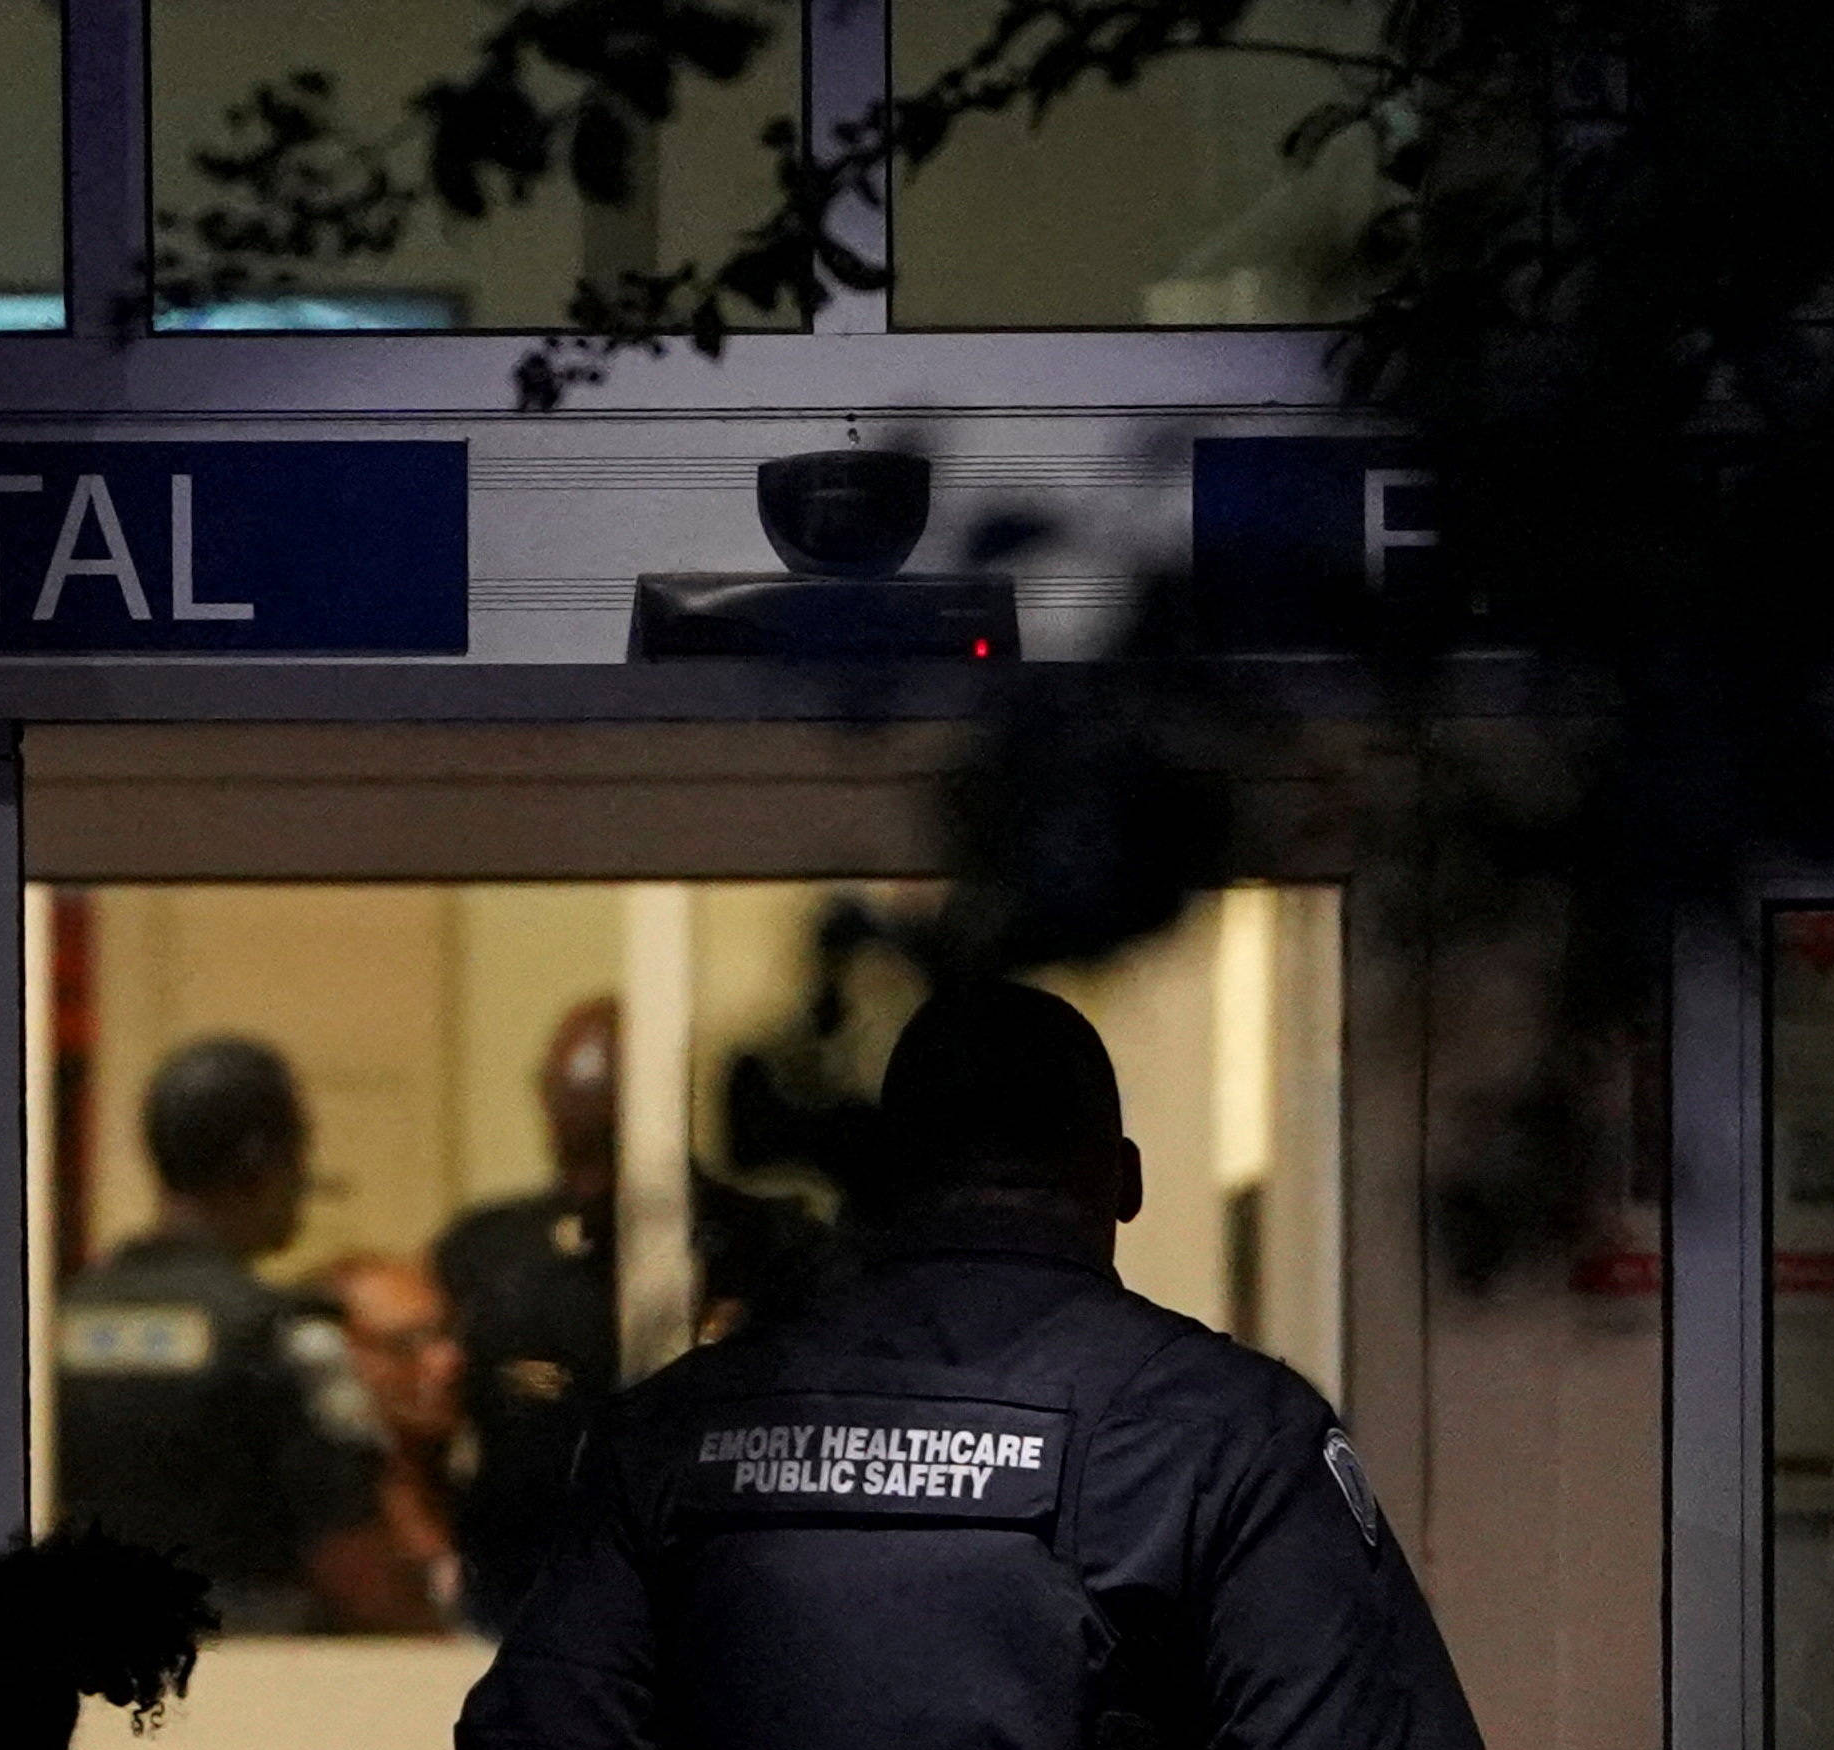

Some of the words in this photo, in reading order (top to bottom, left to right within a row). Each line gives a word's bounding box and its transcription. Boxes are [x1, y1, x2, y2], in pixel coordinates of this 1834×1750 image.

[698, 1424, 814, 1463] EMORY
[820, 1425, 1045, 1470] HEALTHCARE
[733, 1460, 857, 1494] PUBLIC
[862, 1460, 995, 1500] SAFETY
